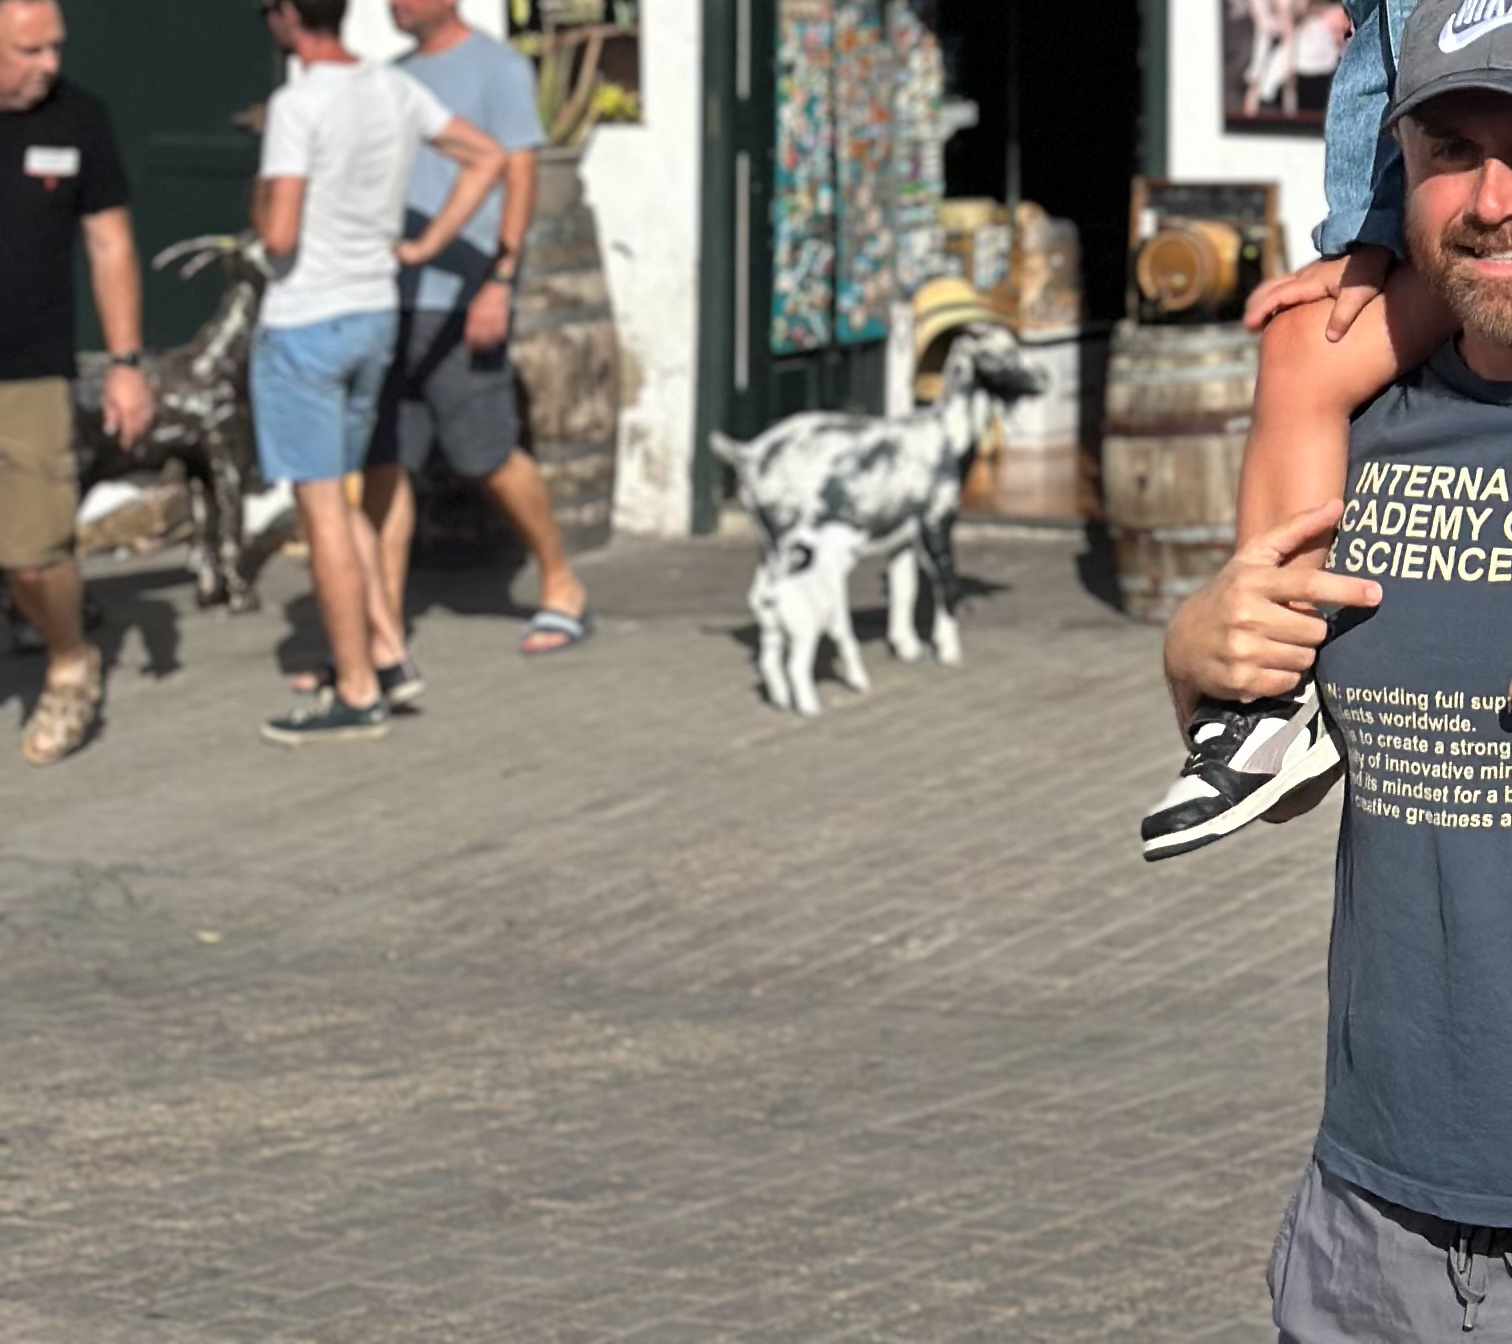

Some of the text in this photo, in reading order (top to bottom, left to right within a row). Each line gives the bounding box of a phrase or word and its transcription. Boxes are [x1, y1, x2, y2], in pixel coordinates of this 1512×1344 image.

[1338, 499, 1493, 542] CADEMY
[1346, 686, 1429, 711] providing
[1434, 691, 1464, 710] full
[1379, 712, 1478, 733] worldwide.
[1359, 727, 1373, 745] to
[1377, 732, 1429, 752] create
[1434, 740, 1445, 755] a
[1450, 740, 1512, 760] strong
[1368, 751, 1382, 769] of
[1385, 753, 1475, 780] innovative
[1383, 779, 1449, 804] mindset
[1453, 785, 1482, 804] for
[1486, 789, 1498, 804] a
[1405, 806, 1494, 829] greatness
